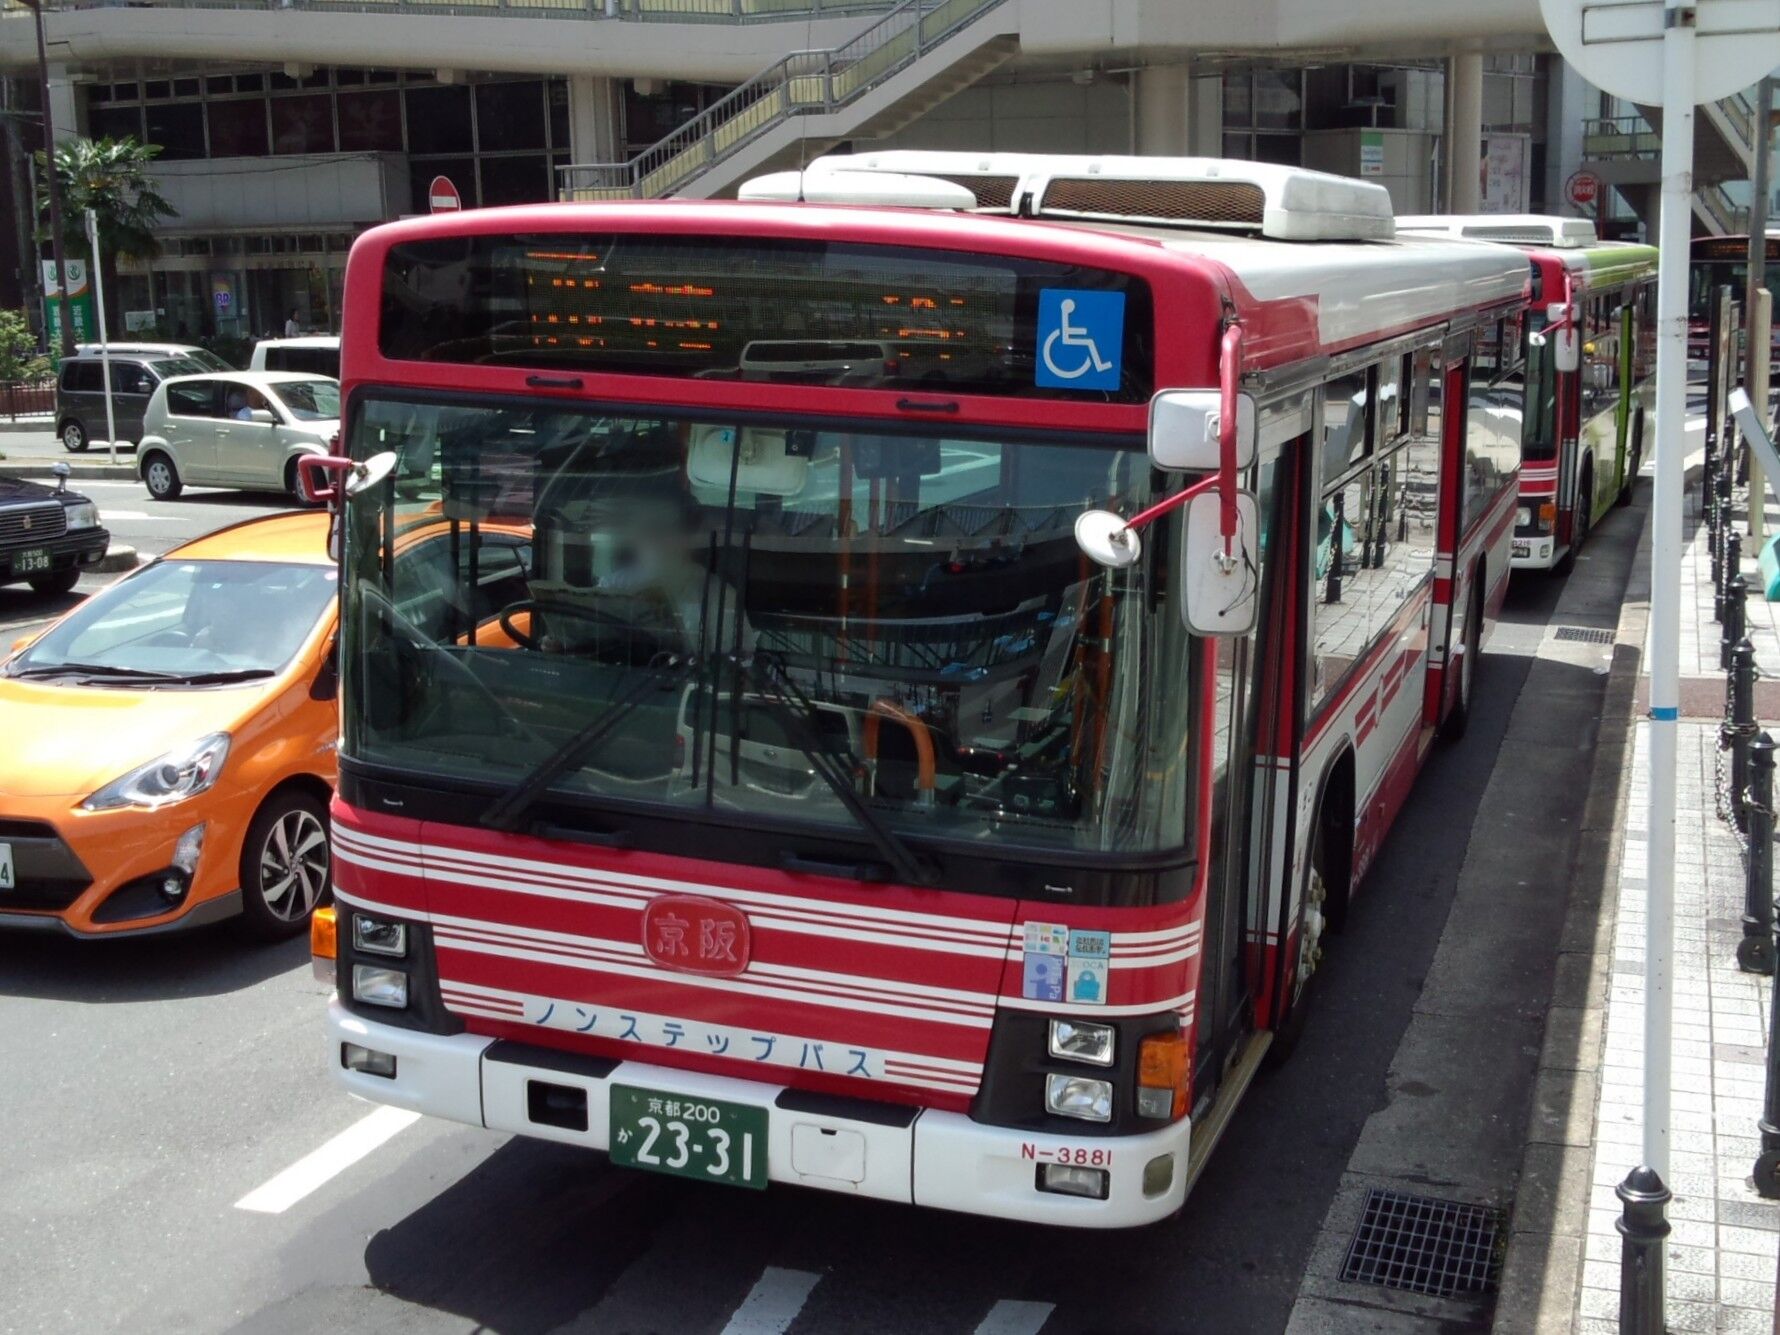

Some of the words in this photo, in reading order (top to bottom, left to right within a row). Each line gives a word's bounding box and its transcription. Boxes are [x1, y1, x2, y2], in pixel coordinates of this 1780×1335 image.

[654, 912, 737, 961] 京阪
[536, 1004, 872, 1077] ノンステップバス
[617, 1128, 633, 1144] か
[637, 1117, 752, 1181] 23-31
[1022, 1142, 1112, 1166] N-3881
